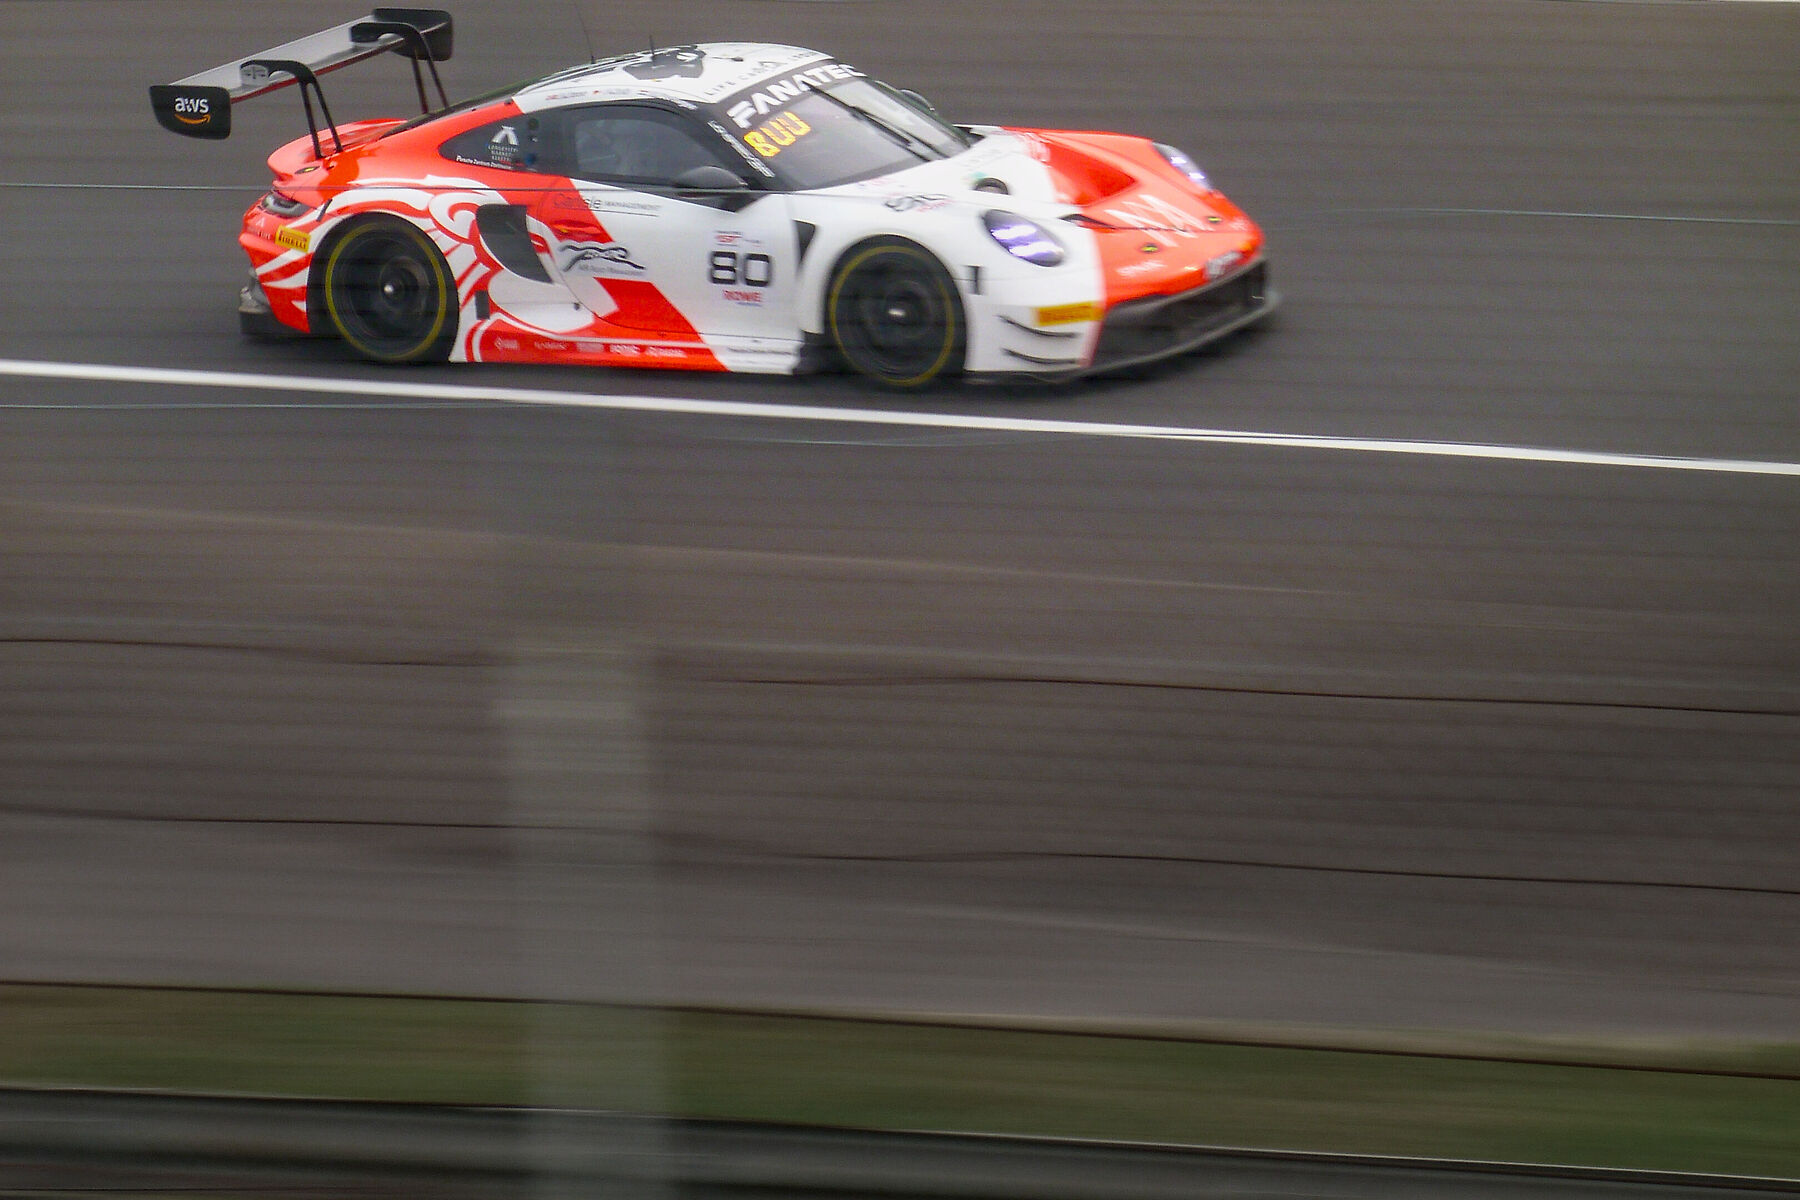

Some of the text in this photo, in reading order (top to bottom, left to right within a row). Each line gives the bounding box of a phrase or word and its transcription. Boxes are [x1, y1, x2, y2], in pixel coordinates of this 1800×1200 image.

[174, 97, 210, 114] aws
[727, 64, 868, 129] FANATEC
[278, 230, 308, 250] PIRELLI
[708, 250, 775, 288] 80
